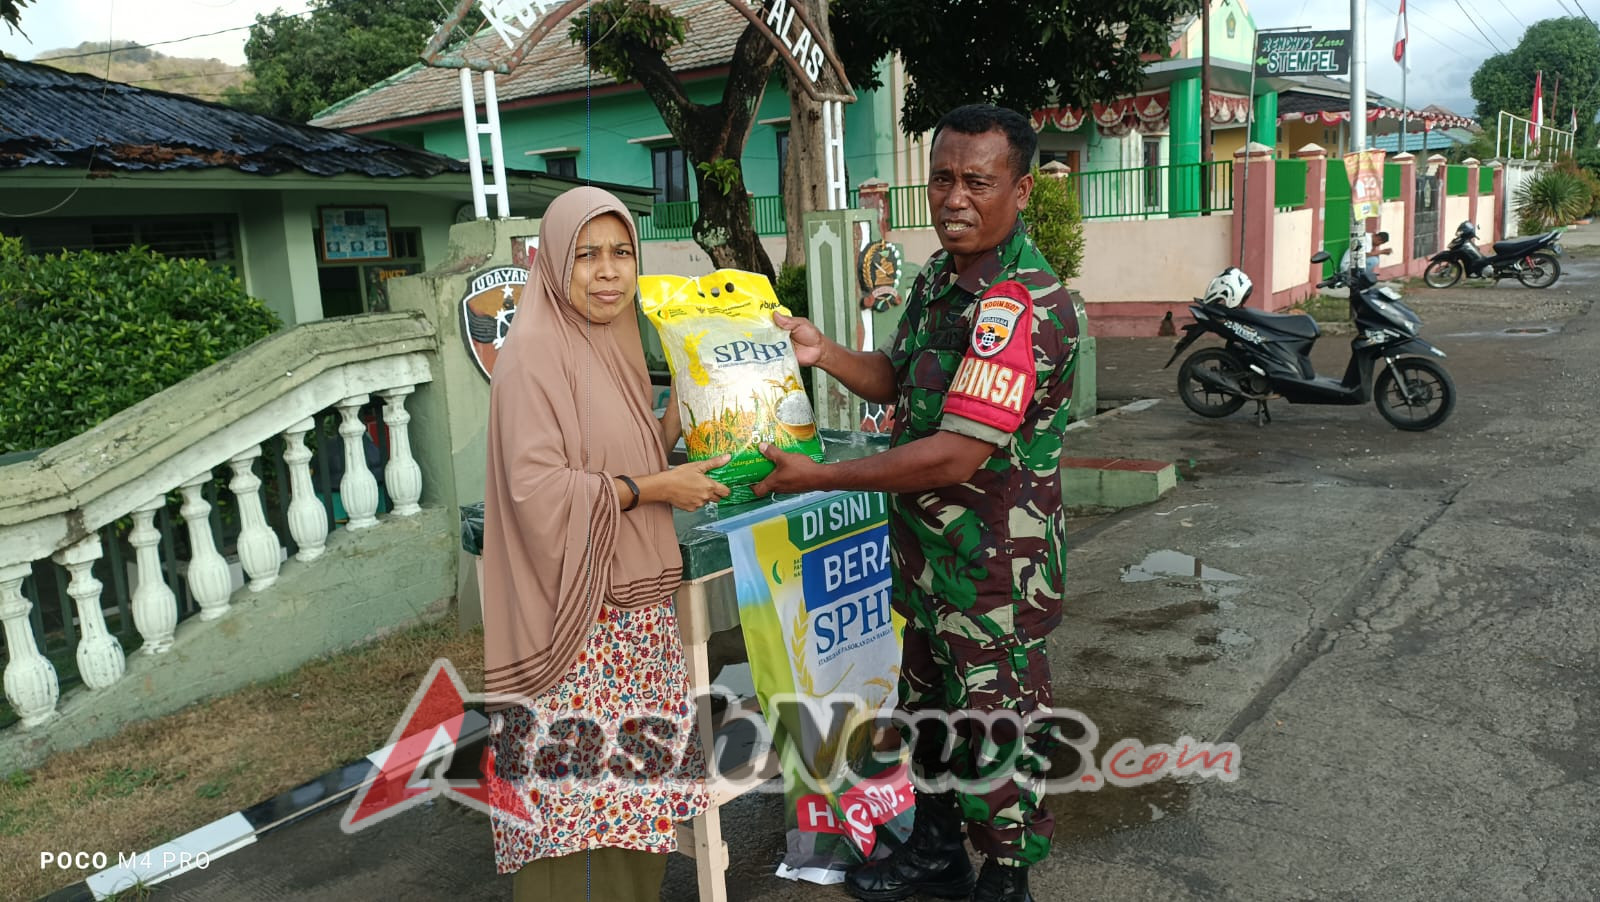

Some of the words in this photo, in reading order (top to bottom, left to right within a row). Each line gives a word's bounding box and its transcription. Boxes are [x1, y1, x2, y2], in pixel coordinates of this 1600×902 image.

[1266, 49, 1339, 73] STEMPEL
[475, 268, 529, 291] UDAYAN
[713, 340, 787, 363] SPHP
[802, 508, 825, 542] DI
[829, 490, 871, 532] SINI
[823, 534, 891, 593] BERA
